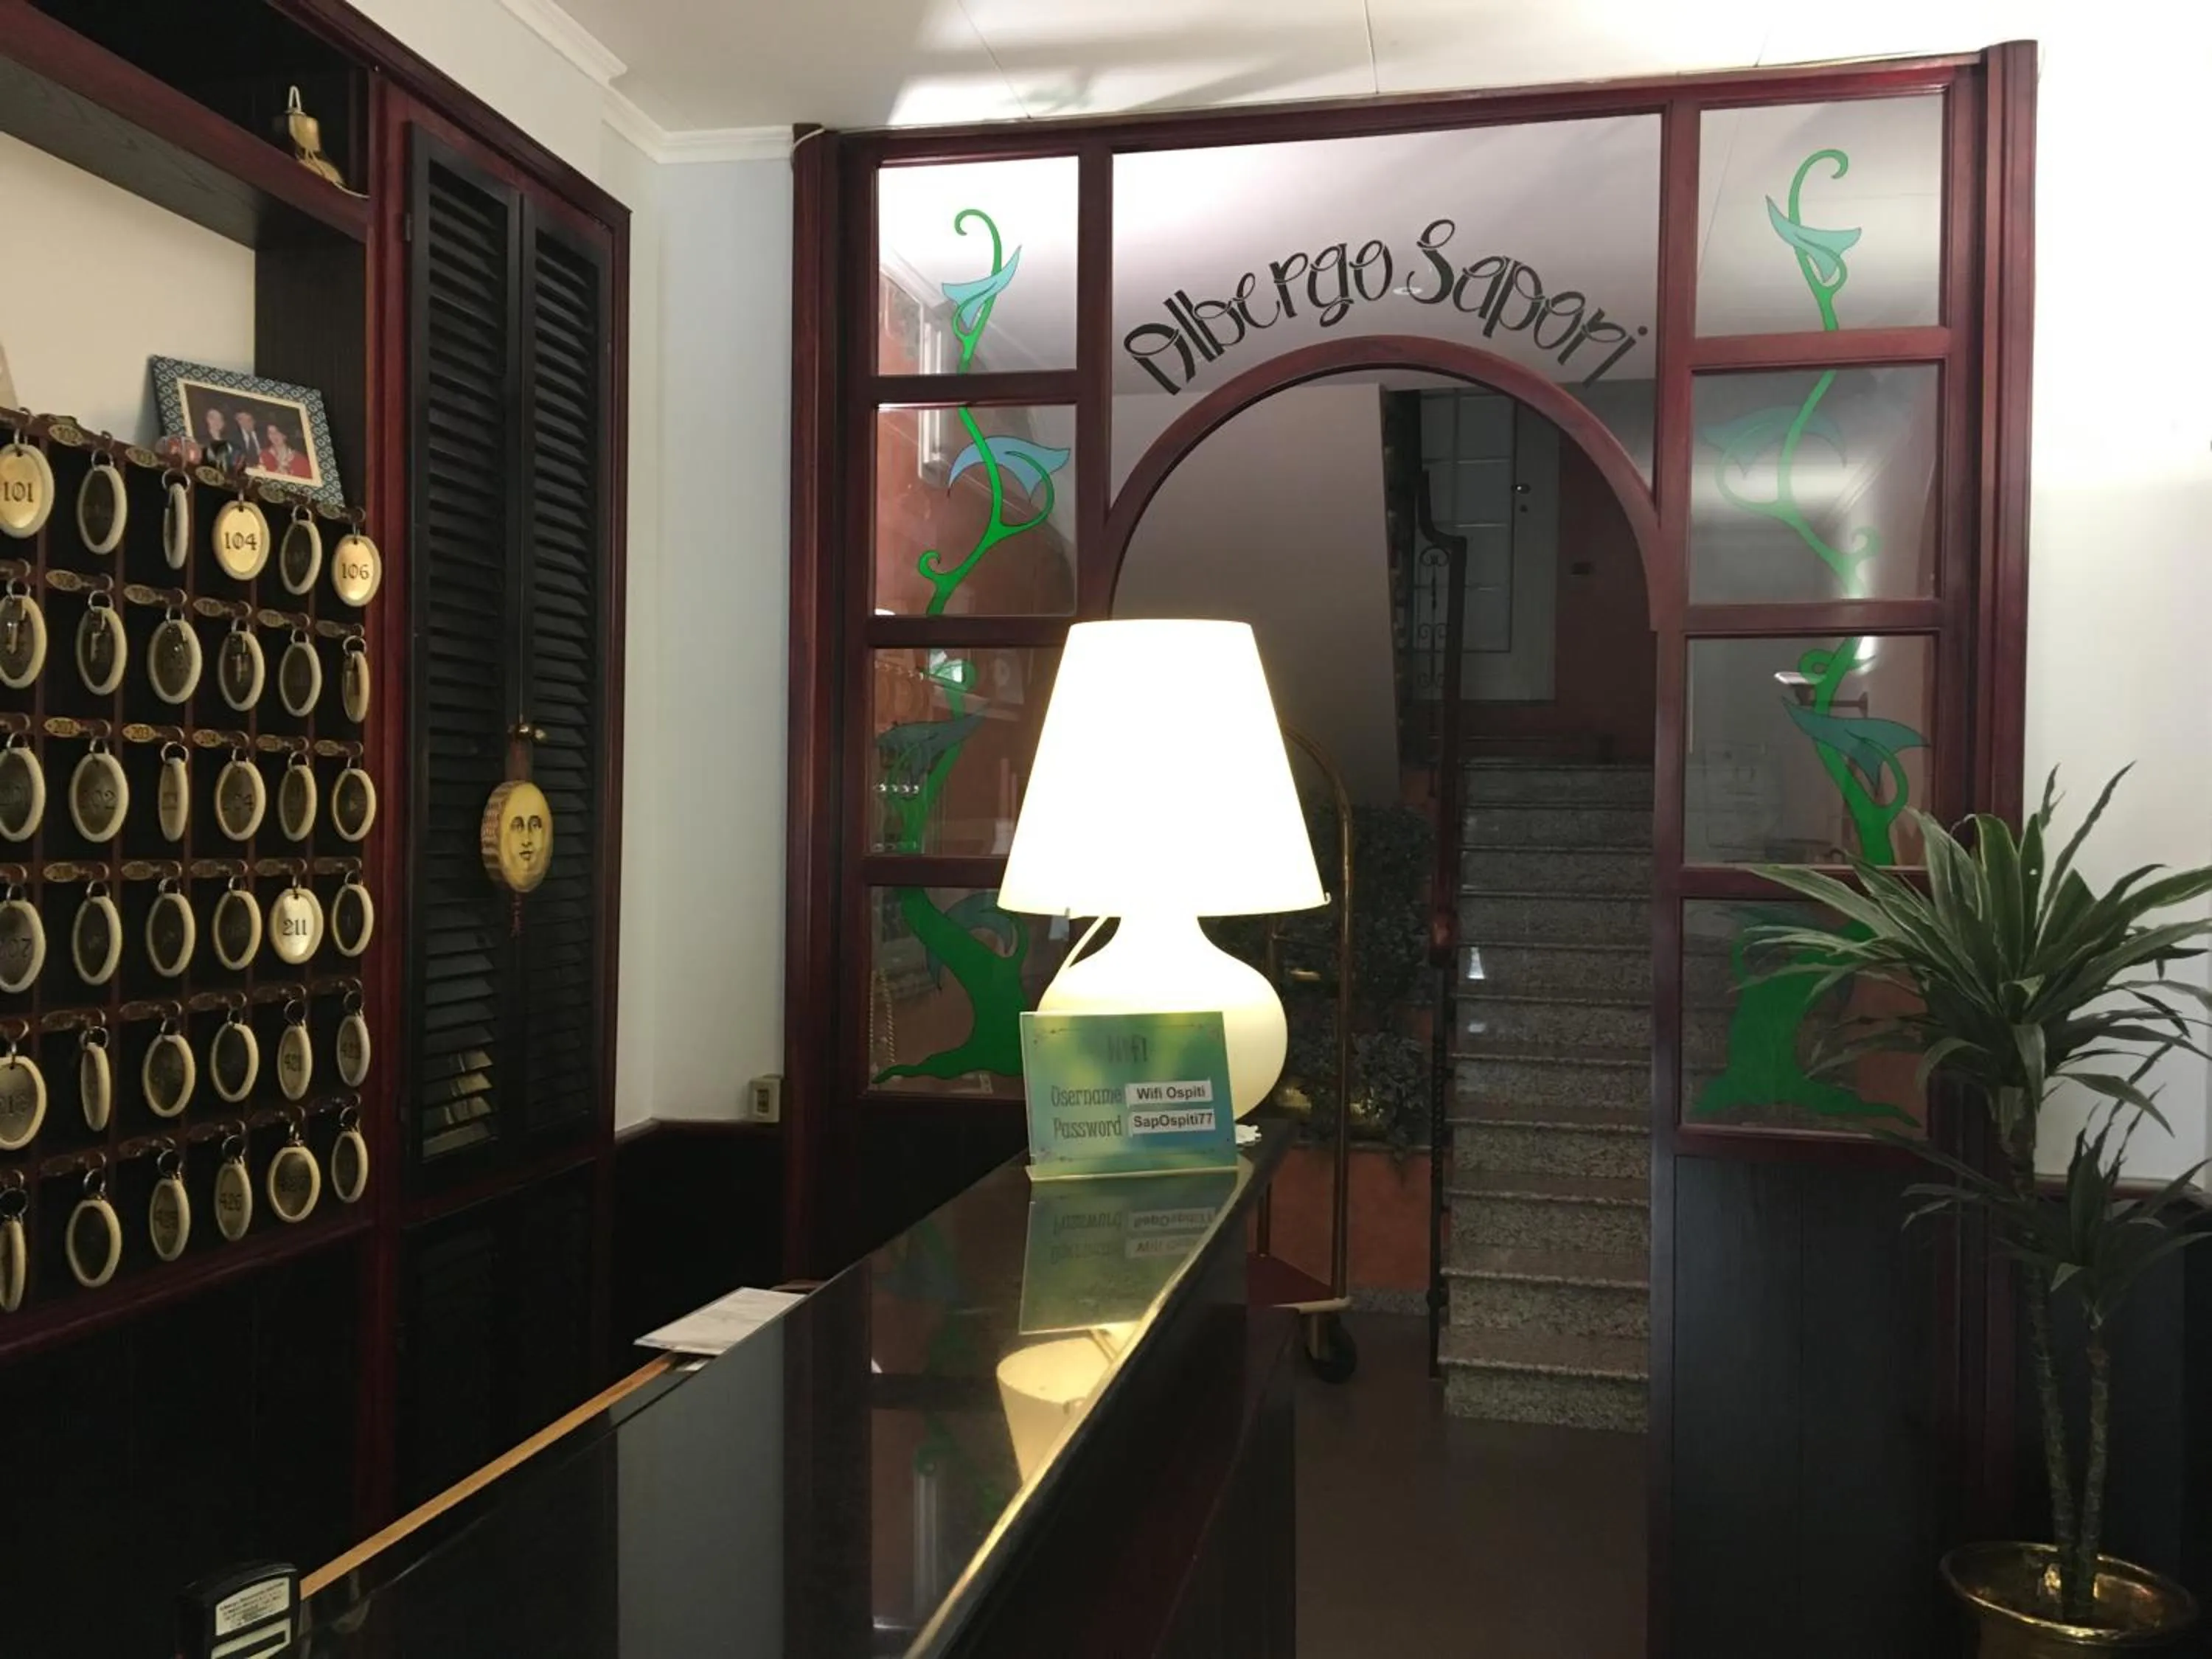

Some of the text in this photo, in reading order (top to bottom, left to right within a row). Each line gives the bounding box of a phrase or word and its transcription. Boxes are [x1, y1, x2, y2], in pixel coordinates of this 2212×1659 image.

[1123, 218, 1649, 396] Albergo Sapori
[2, 481, 35, 503] 101
[223, 531, 257, 550] 104
[341, 562, 370, 580] 106
[282, 918, 307, 936] 211
[1136, 1088, 1163, 1100] Wifi
[1166, 1085, 1206, 1100] Ospiti
[1053, 1112, 1213, 1139] Password SapOspiti77
